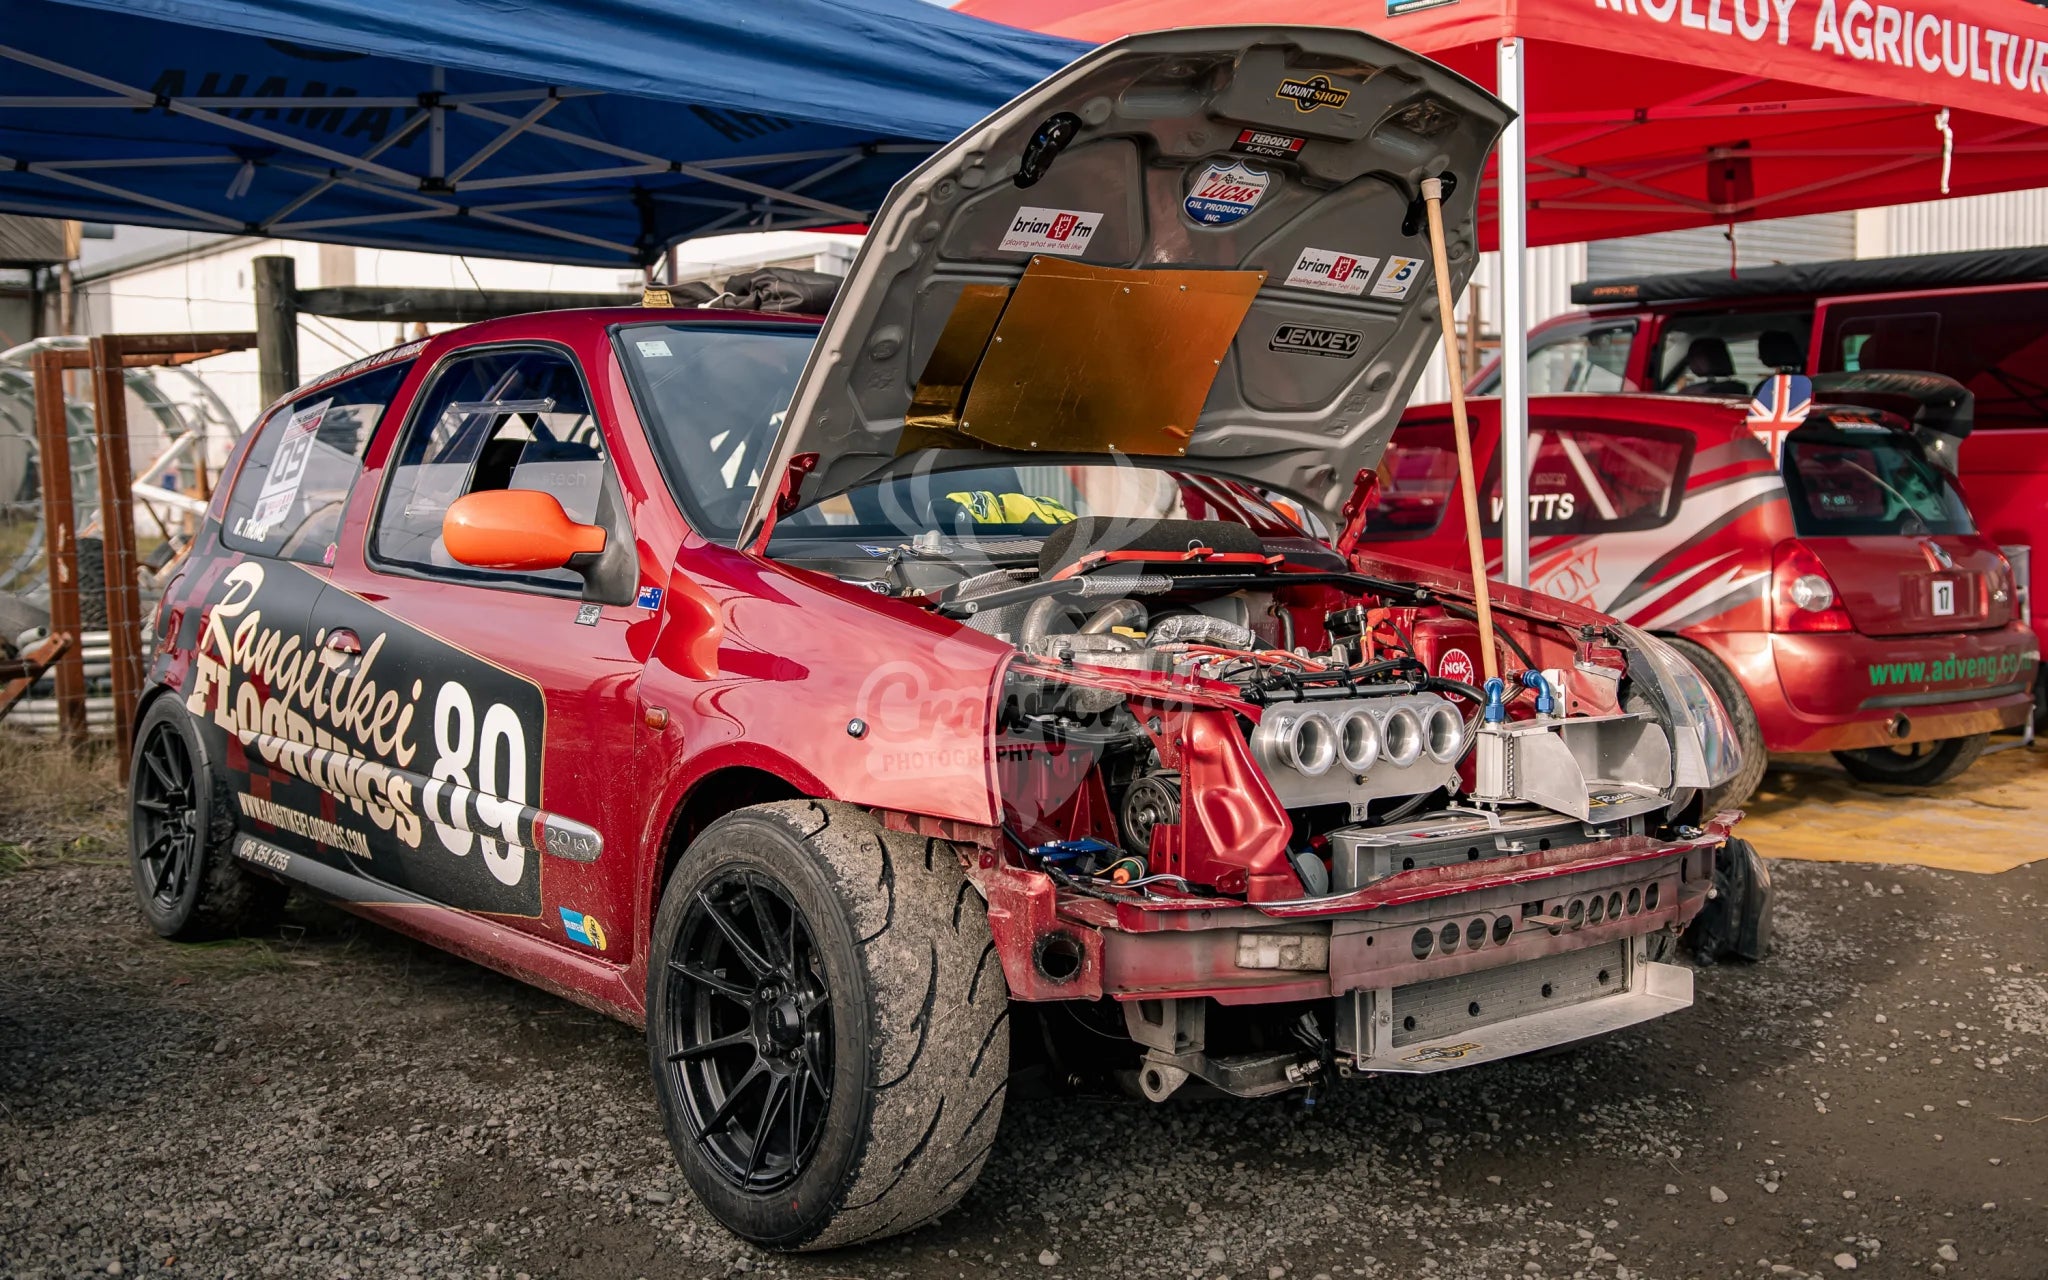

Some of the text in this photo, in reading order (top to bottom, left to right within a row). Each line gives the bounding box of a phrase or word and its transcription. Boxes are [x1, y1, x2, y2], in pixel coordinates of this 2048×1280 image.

[1595, 0, 1797, 45] LLOY
[1280, 83, 1346, 104] MOUNT SHOP
[1245, 145, 1285, 157] RACING
[1251, 133, 1291, 147] FERODO
[1198, 182, 1260, 203] LUCAS
[1187, 200, 1249, 215] OIL PRODUCTS
[1012, 216, 1092, 238] brian fm
[1004, 238, 1029, 248] playing
[1030, 240, 1046, 248] what
[1057, 241, 1070, 250] feel
[1296, 256, 1370, 280] brian fm
[1386, 259, 1417, 281] 75
[1275, 328, 1360, 350] JENVEY
[1490, 493, 1575, 522] WTTS
[1938, 586, 1949, 609] 17
[201, 561, 422, 767] Rangitikei
[1444, 661, 1467, 675] NGK
[1868, 652, 2032, 686] www.adveng.co
[186, 652, 422, 849] FLOORINGS
[422, 681, 527, 887] 89
[240, 838, 291, 872] (06) 354 2755
